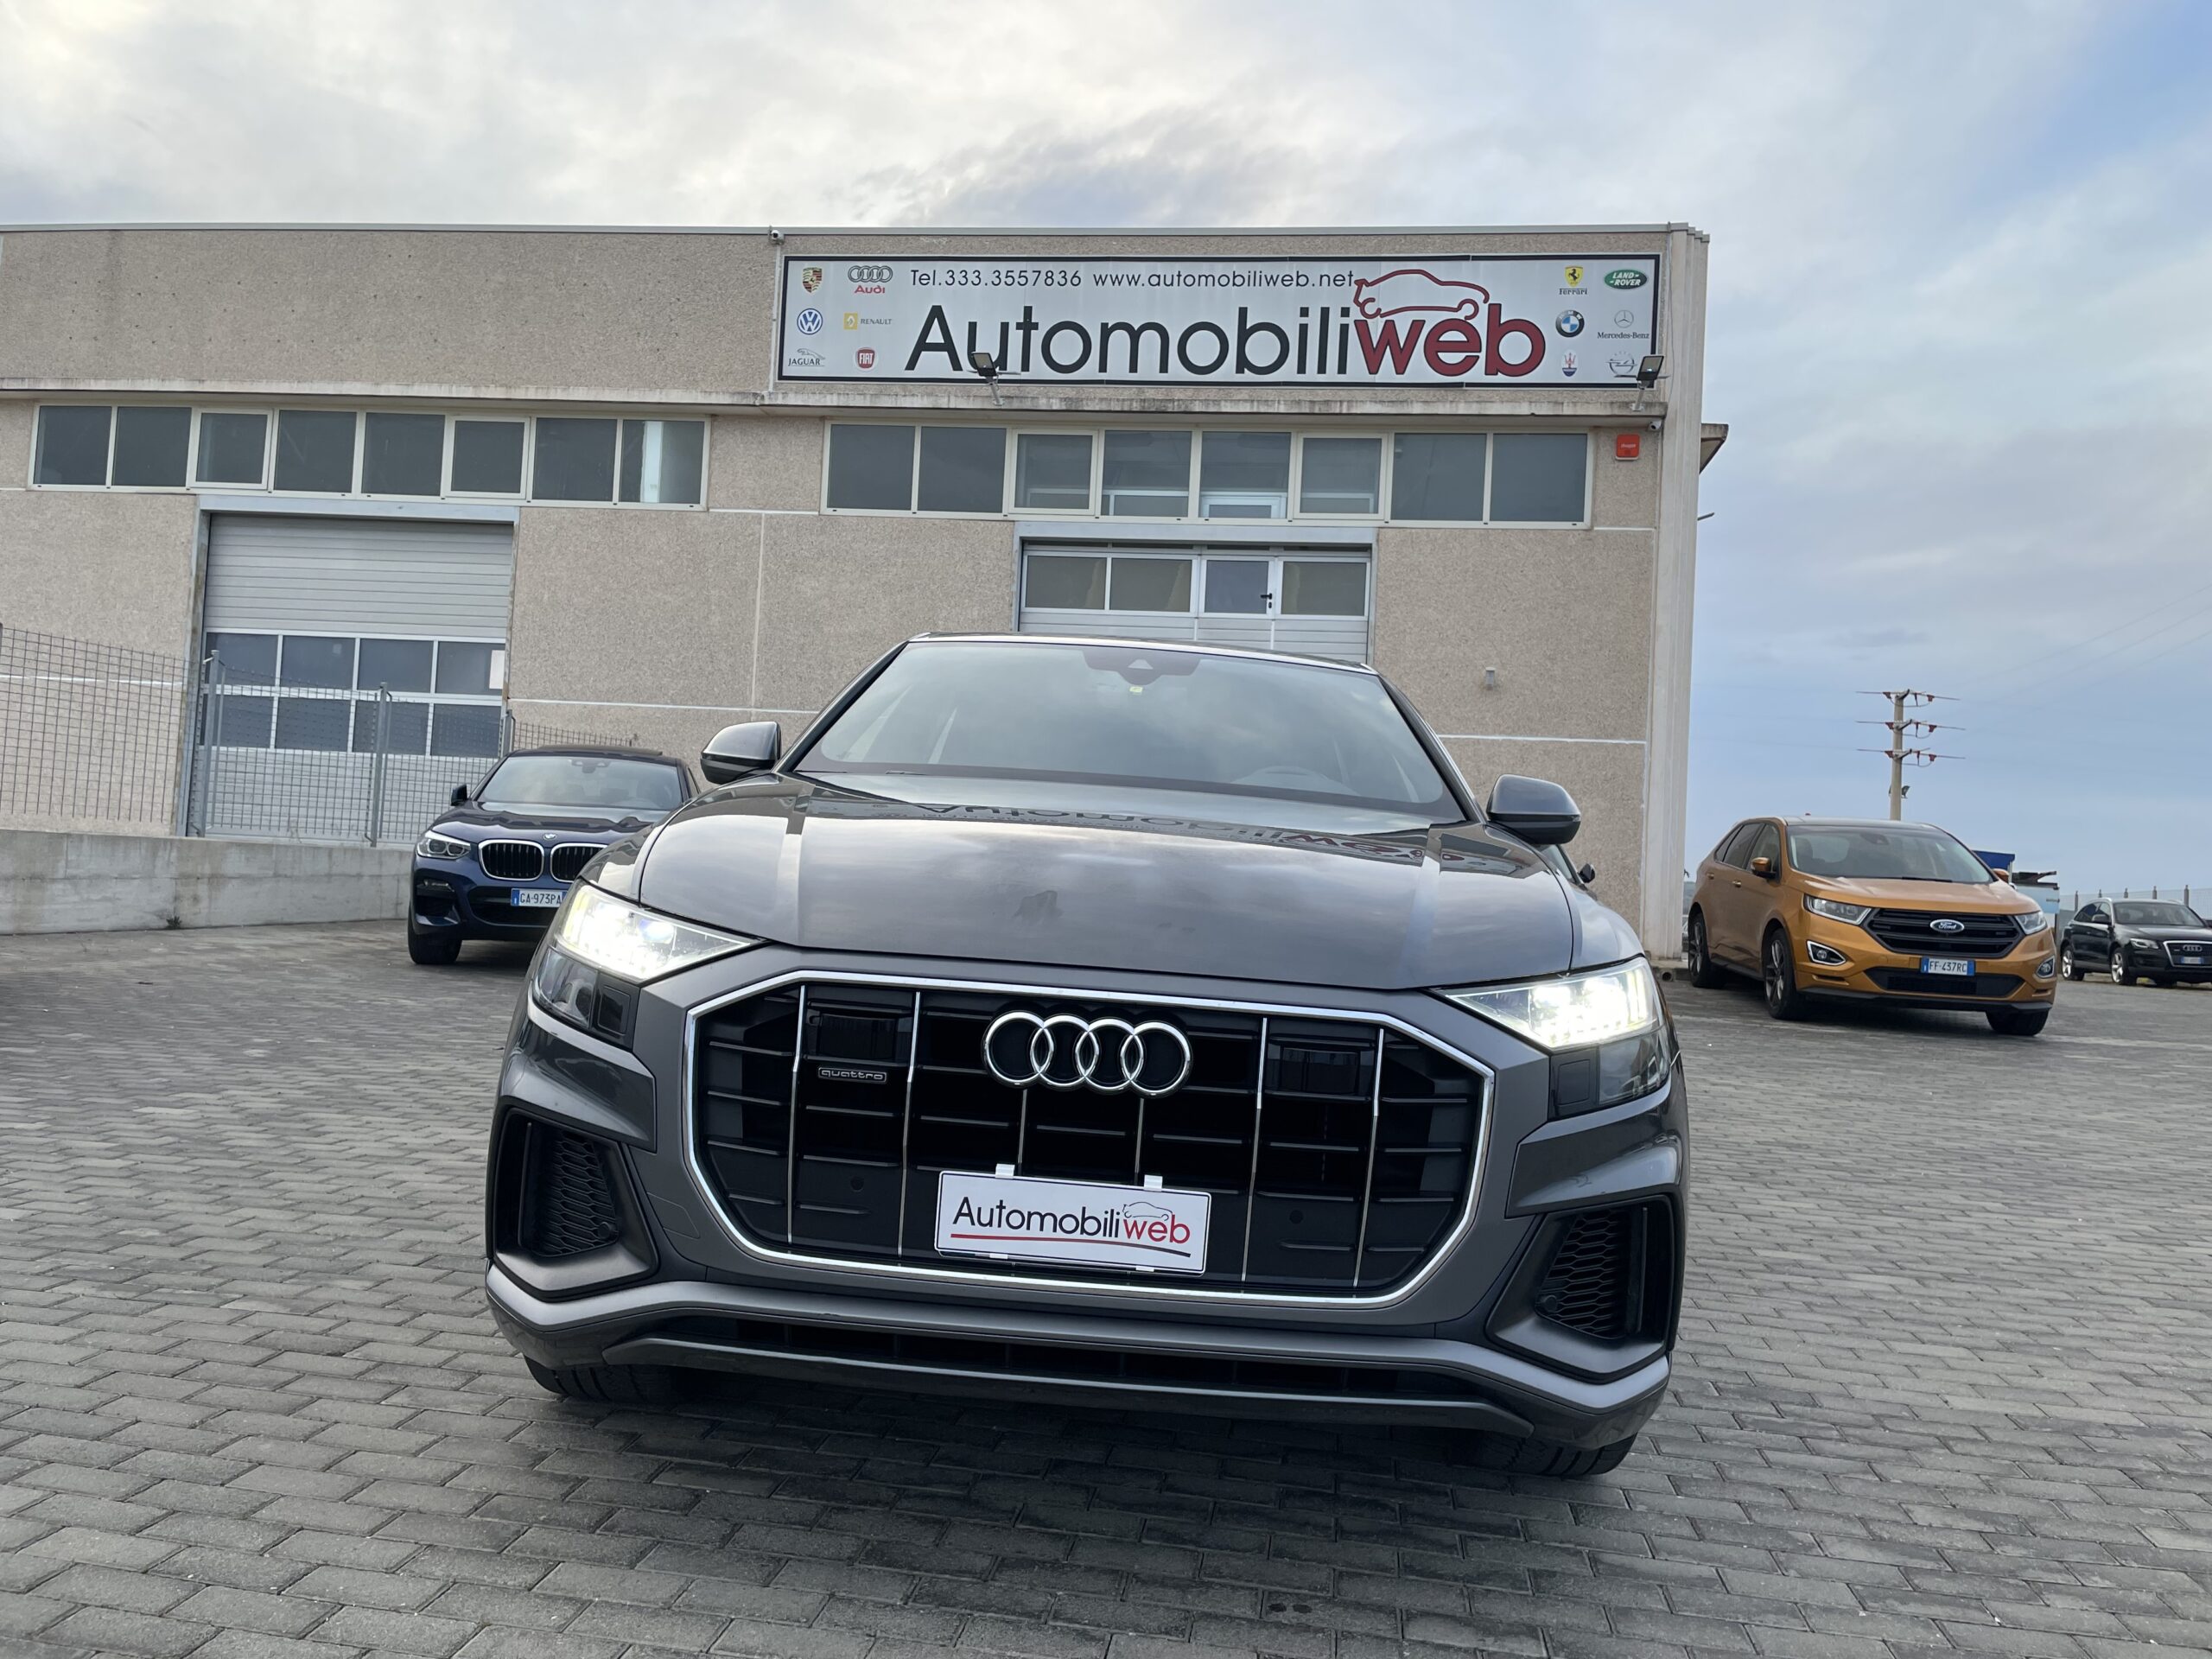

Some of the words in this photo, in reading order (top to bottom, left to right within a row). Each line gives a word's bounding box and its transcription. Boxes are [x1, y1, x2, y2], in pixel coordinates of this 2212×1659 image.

[1093, 270, 1354, 288] www.automobiliweb.net
[855, 285, 886, 294] Audi
[788, 358, 820, 366] JAGUAR
[859, 353, 874, 364] FIAT
[821, 1070, 884, 1080] quattro
[952, 1196, 1191, 1244] Automobiliweb
